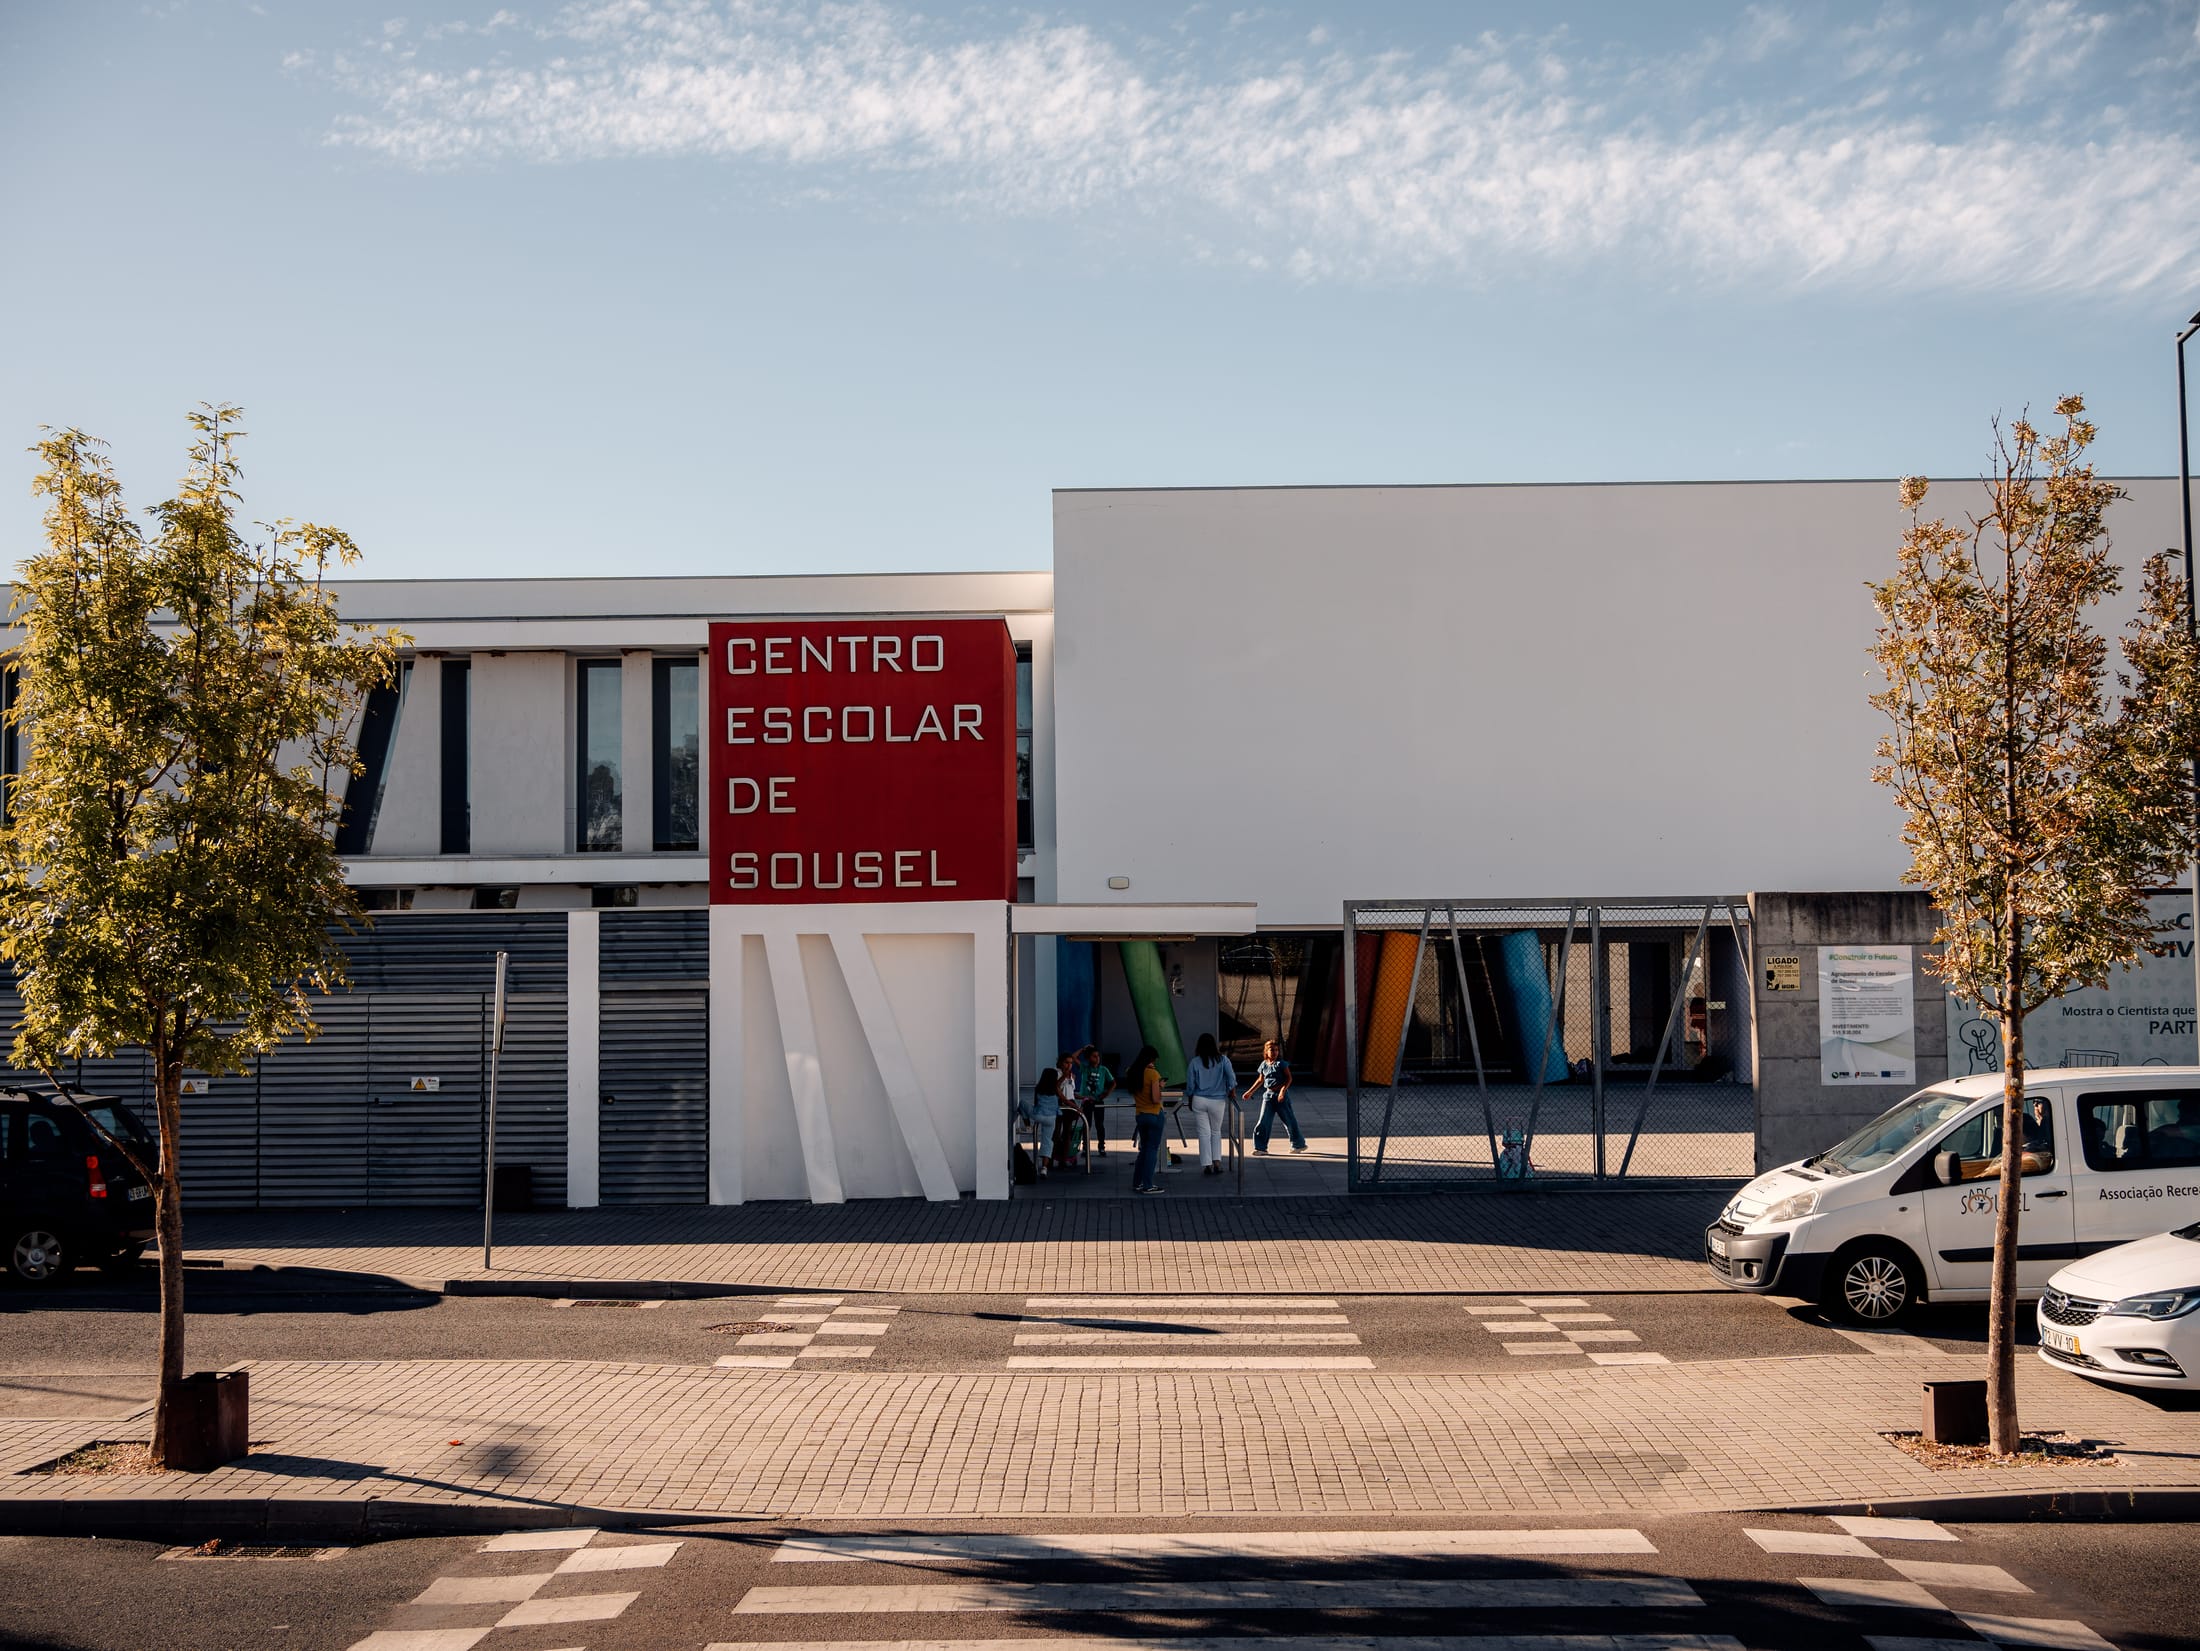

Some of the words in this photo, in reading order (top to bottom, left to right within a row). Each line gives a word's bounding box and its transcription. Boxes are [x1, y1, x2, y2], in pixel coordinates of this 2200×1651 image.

[727, 635, 944, 675] CENTRO
[727, 704, 985, 744] ESCOLAR
[728, 776, 797, 814] DE
[729, 850, 957, 889] SOUSEL
[2062, 1006, 2103, 1016] Mostra
[2106, 1008, 2114, 1016] o
[2117, 1006, 2169, 1016] Cientista
[2172, 1007, 2196, 1018] que
[2099, 1185, 2163, 1202] Associação
